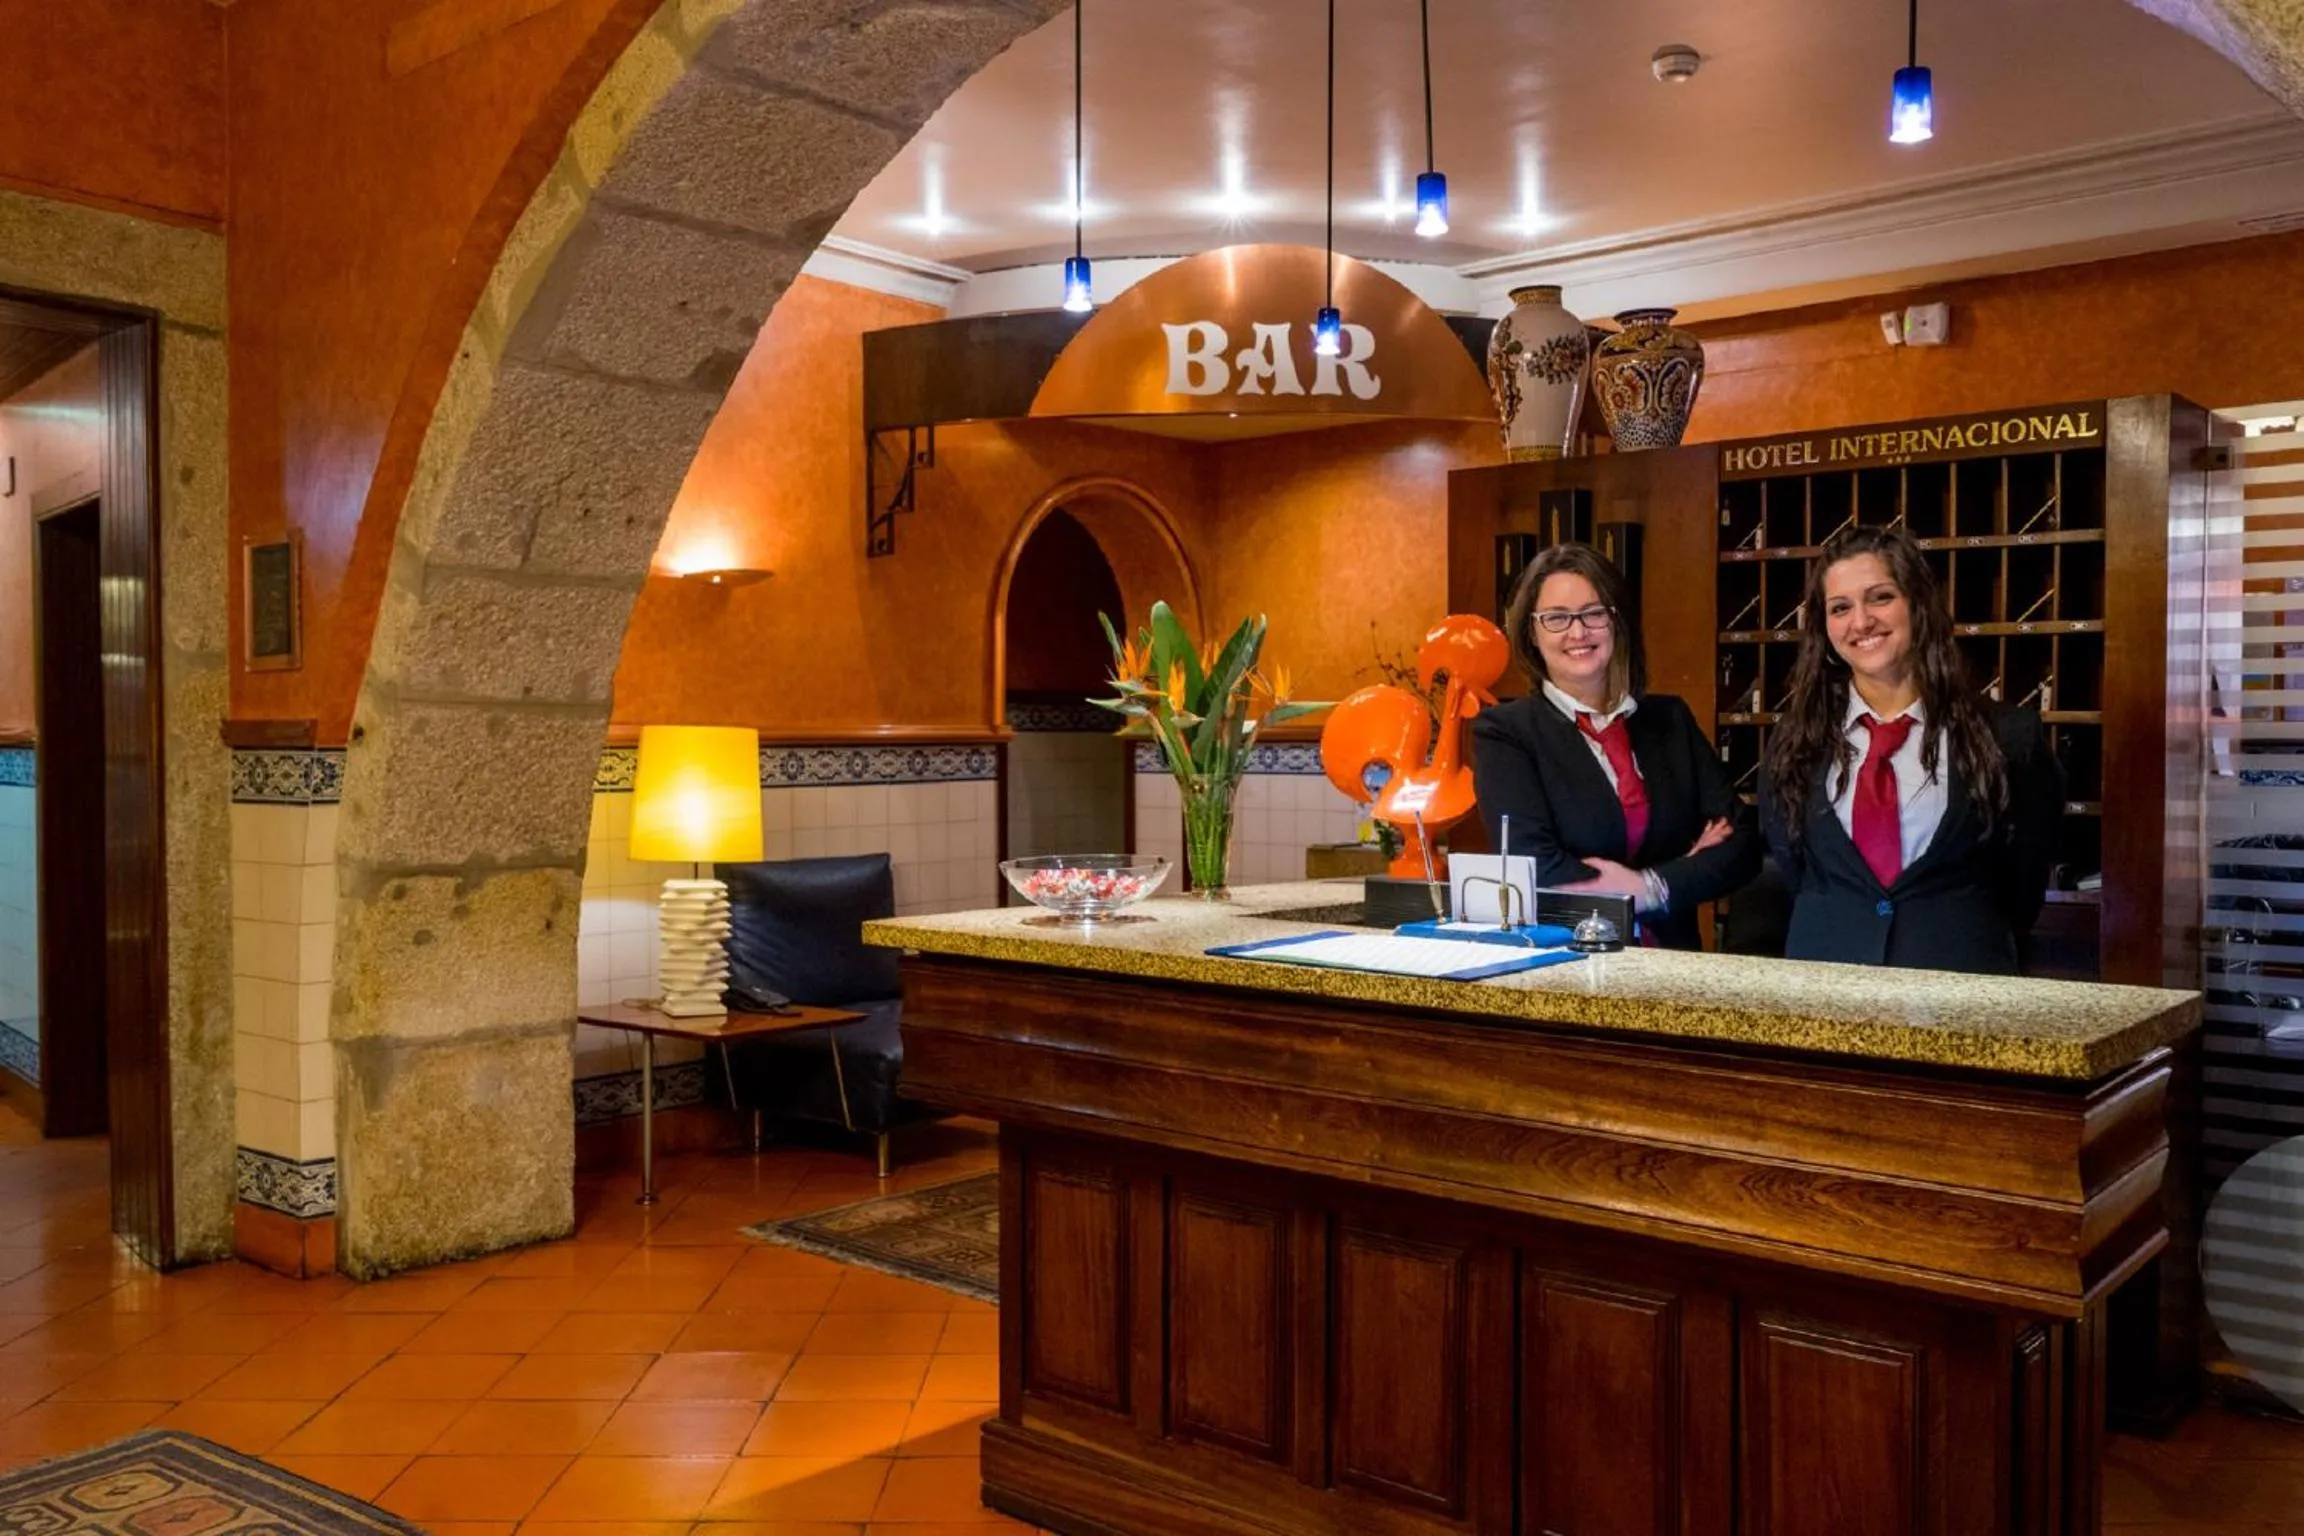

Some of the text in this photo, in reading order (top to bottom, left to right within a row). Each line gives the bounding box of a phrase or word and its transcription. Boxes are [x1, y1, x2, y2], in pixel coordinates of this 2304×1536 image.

[1161, 321, 1381, 399] BAR
[1725, 412, 2098, 471] HOTEL INTERNACIONAL
